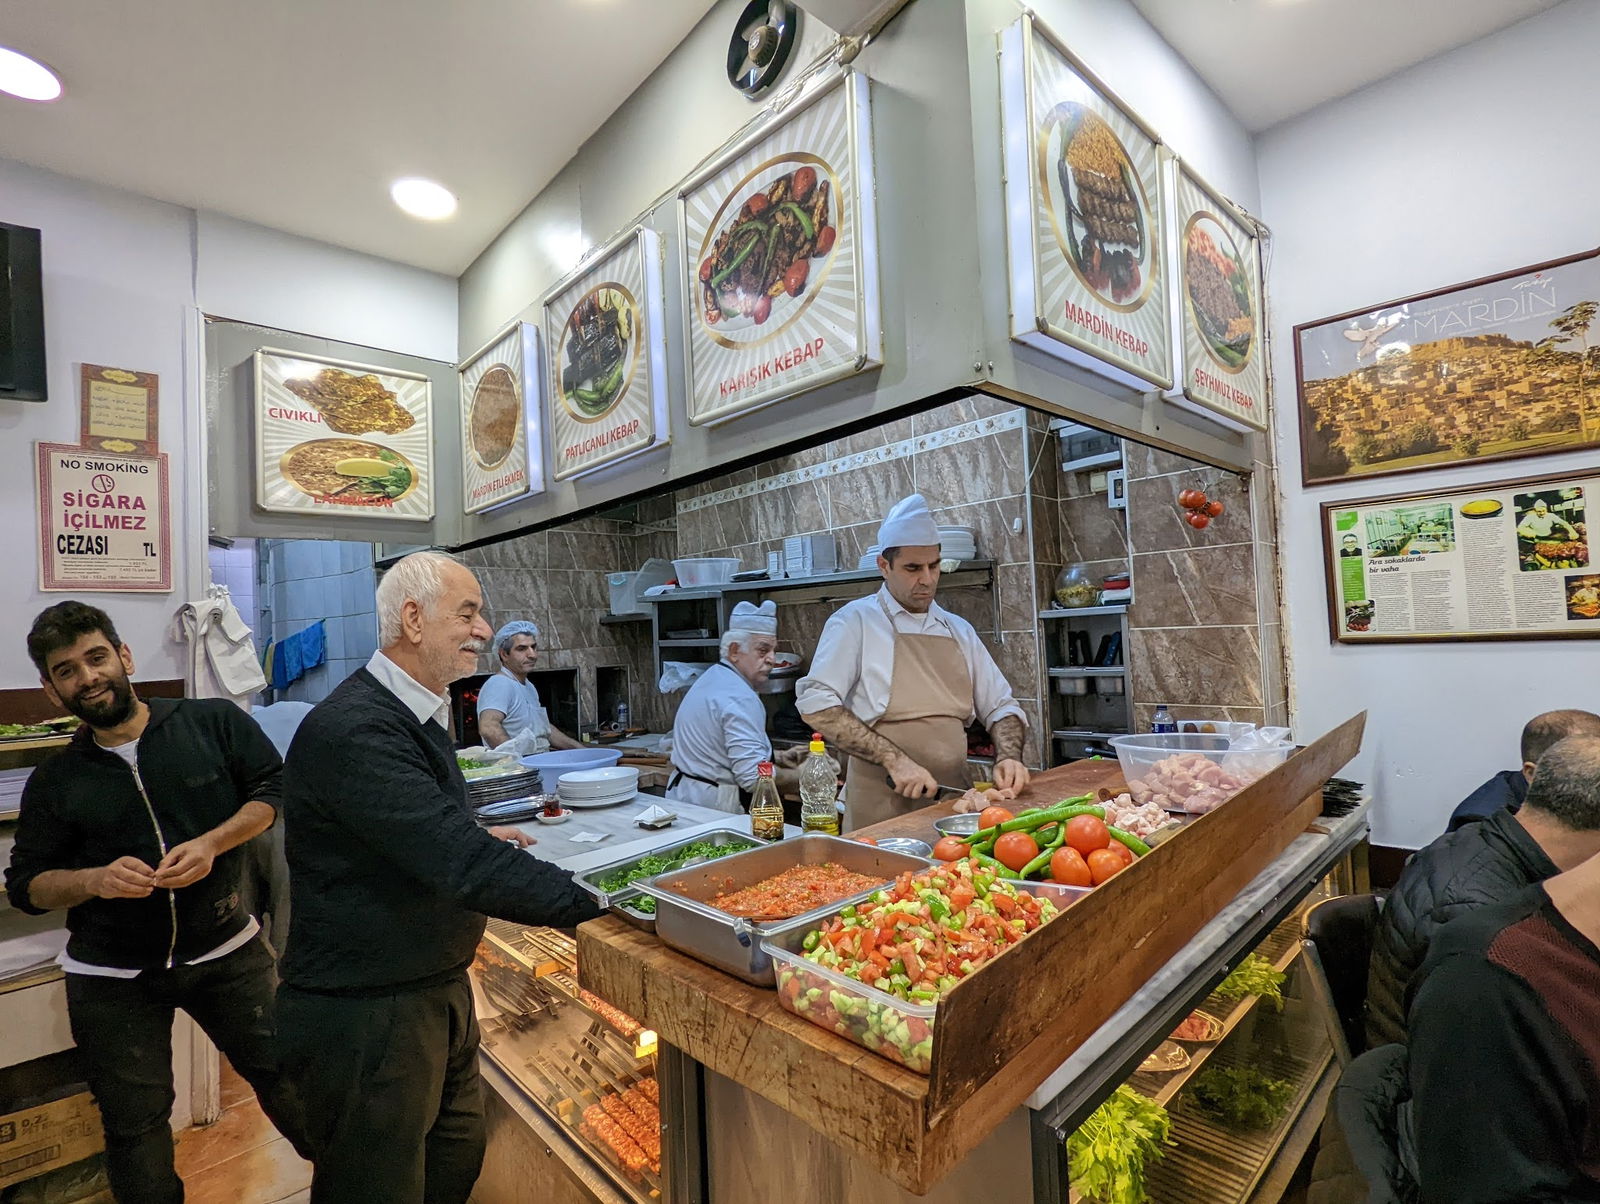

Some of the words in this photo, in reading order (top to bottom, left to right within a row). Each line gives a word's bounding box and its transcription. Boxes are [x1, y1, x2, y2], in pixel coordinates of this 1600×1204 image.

[1414, 287, 1556, 338] MARDİN
[1065, 300, 1113, 342] MARDİN
[1115, 326, 1149, 358] KEBAP
[719, 362, 772, 398] KARIŞIK
[774, 337, 824, 374] KEBAP
[1231, 387, 1253, 409] KEBAP
[565, 431, 609, 460] PATLICANLI
[610, 419, 639, 442] KEBAP
[60, 459, 81, 470] NO
[85, 461, 149, 474] SMOKİNG
[504, 468, 524, 486] EKMEK
[62, 489, 146, 510] SİGARA
[63, 510, 147, 532] İÇİLMEZ
[57, 534, 109, 556] CEZASI
[143, 542, 157, 557] TL
[1384, 555, 1426, 565] sokaklarda
